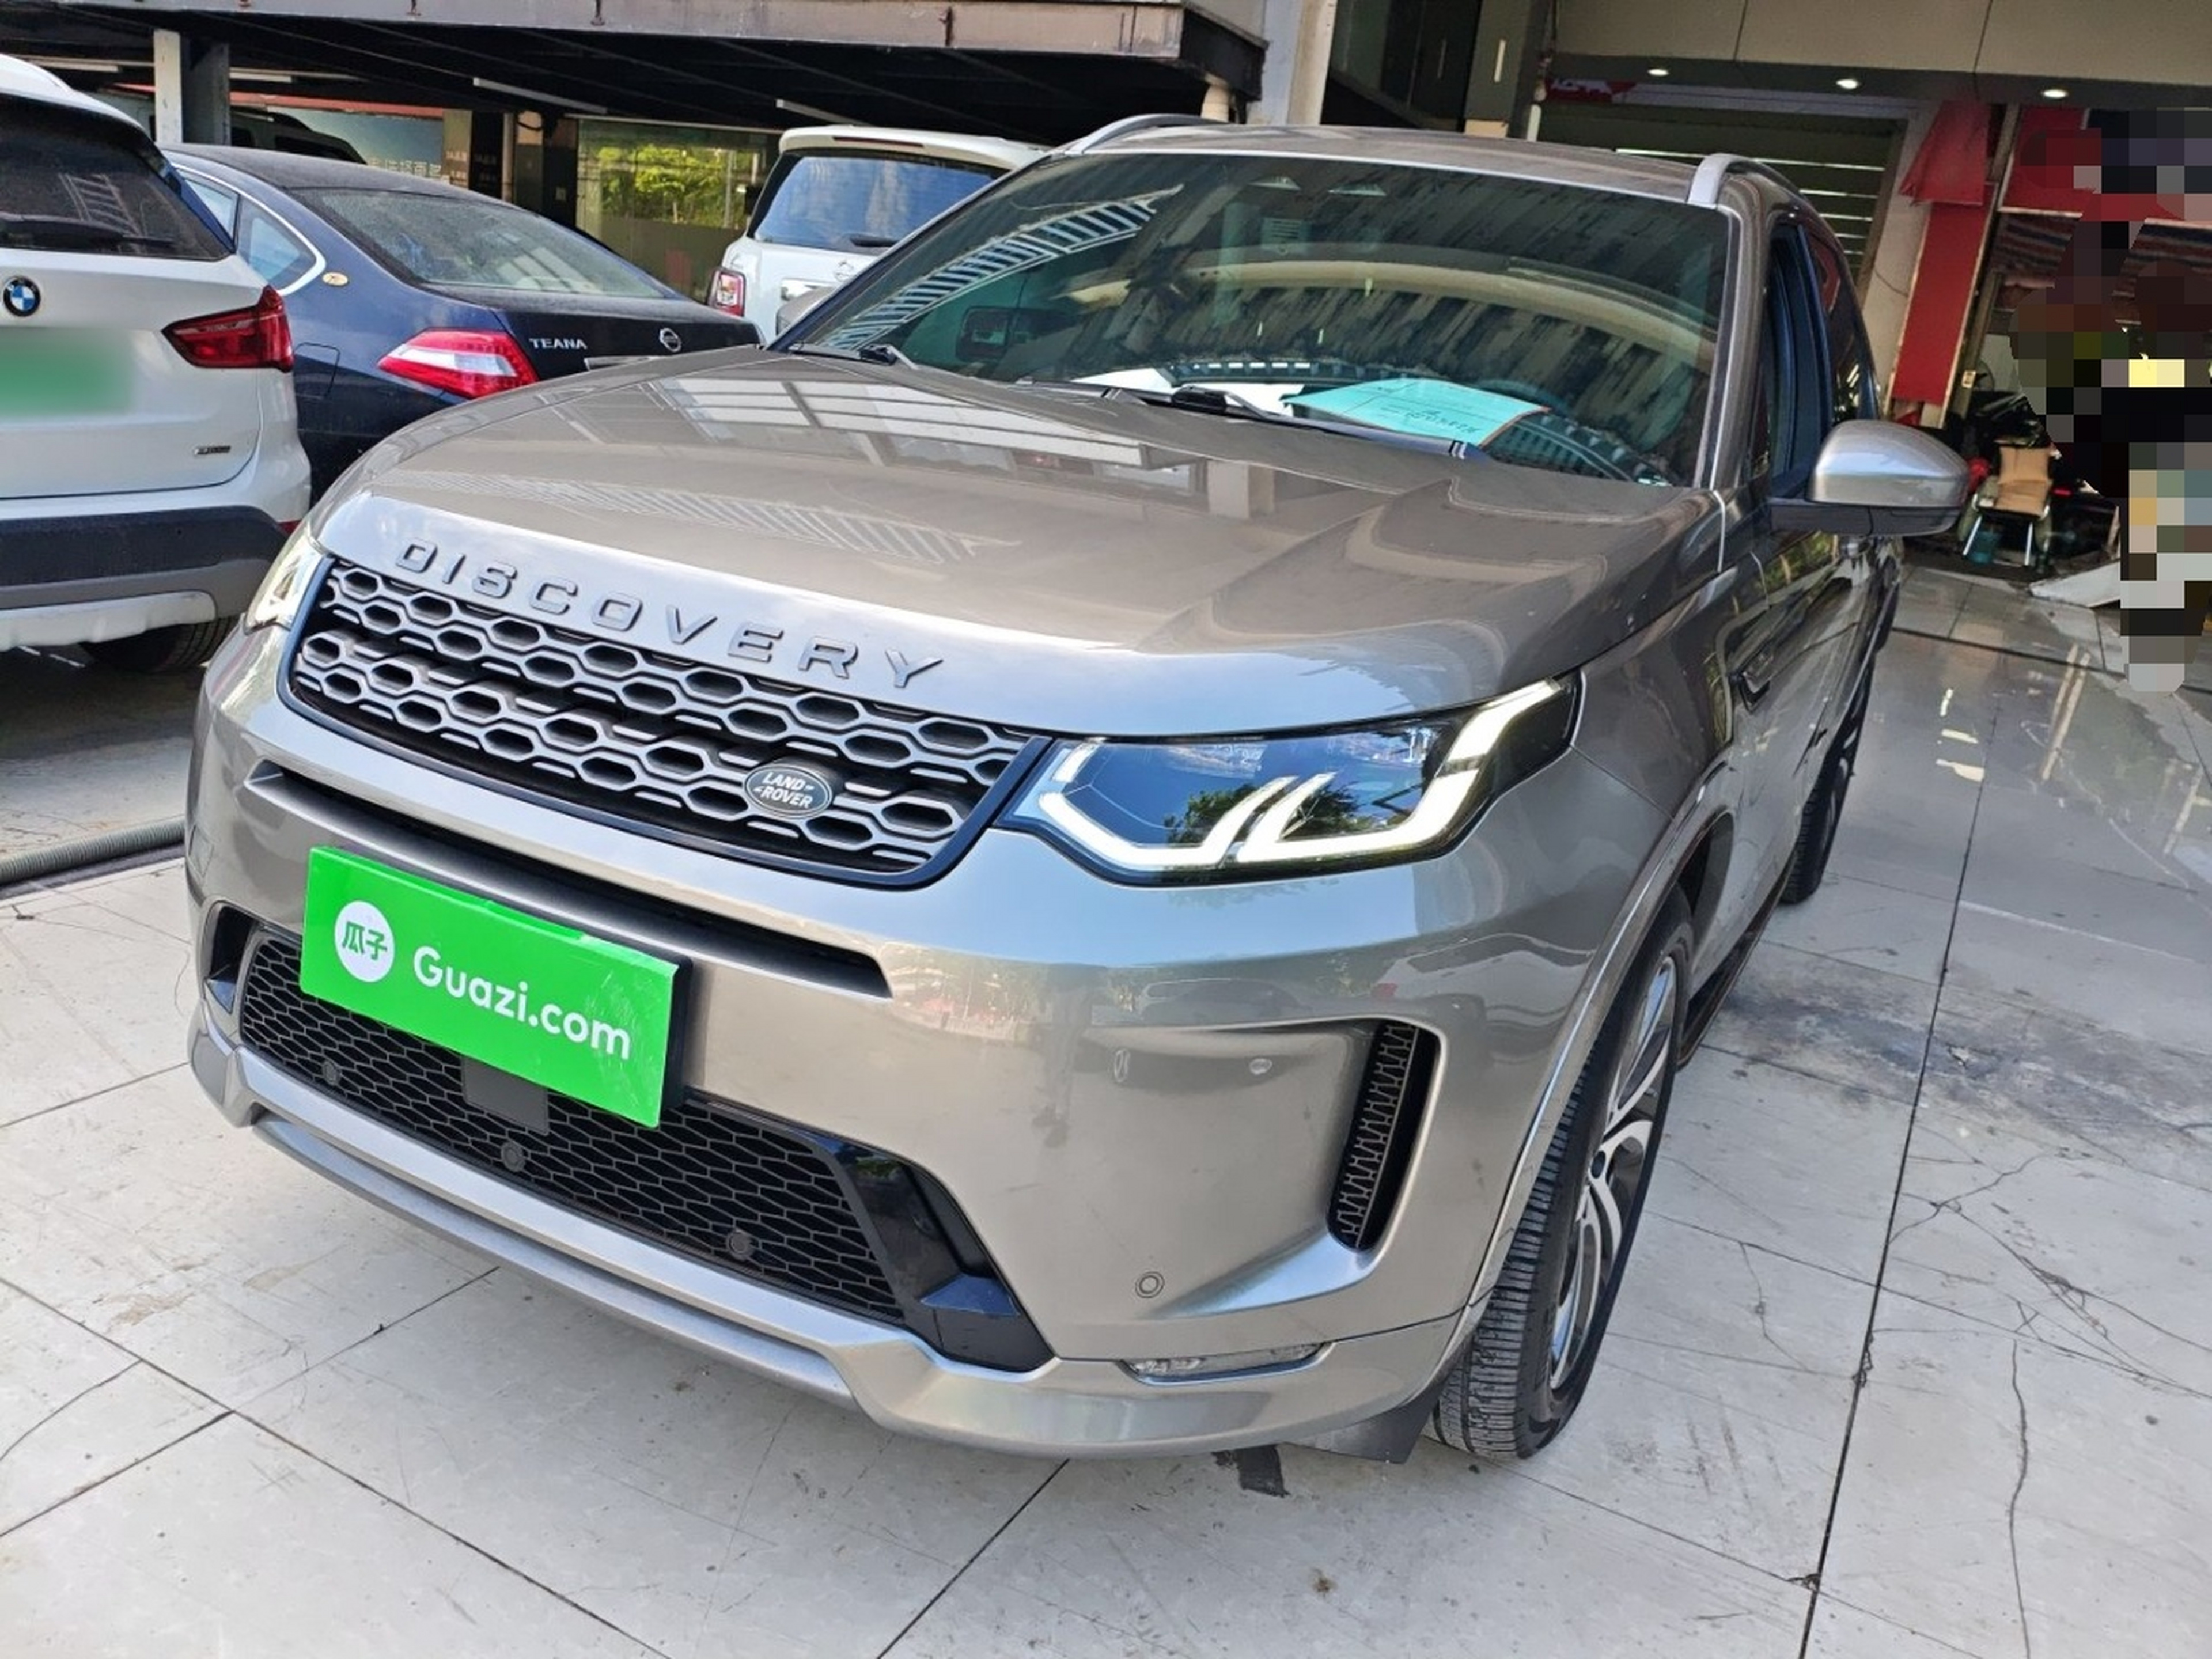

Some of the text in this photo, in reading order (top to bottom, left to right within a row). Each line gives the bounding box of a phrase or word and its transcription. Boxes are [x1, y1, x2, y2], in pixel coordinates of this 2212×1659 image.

[529, 338, 588, 350] TEANA
[395, 537, 943, 689] DISCOVERY
[762, 772, 805, 791] LAND
[760, 786, 813, 809] ROVER
[342, 921, 388, 961] 瓜子
[414, 946, 630, 1060] Guazi.com
